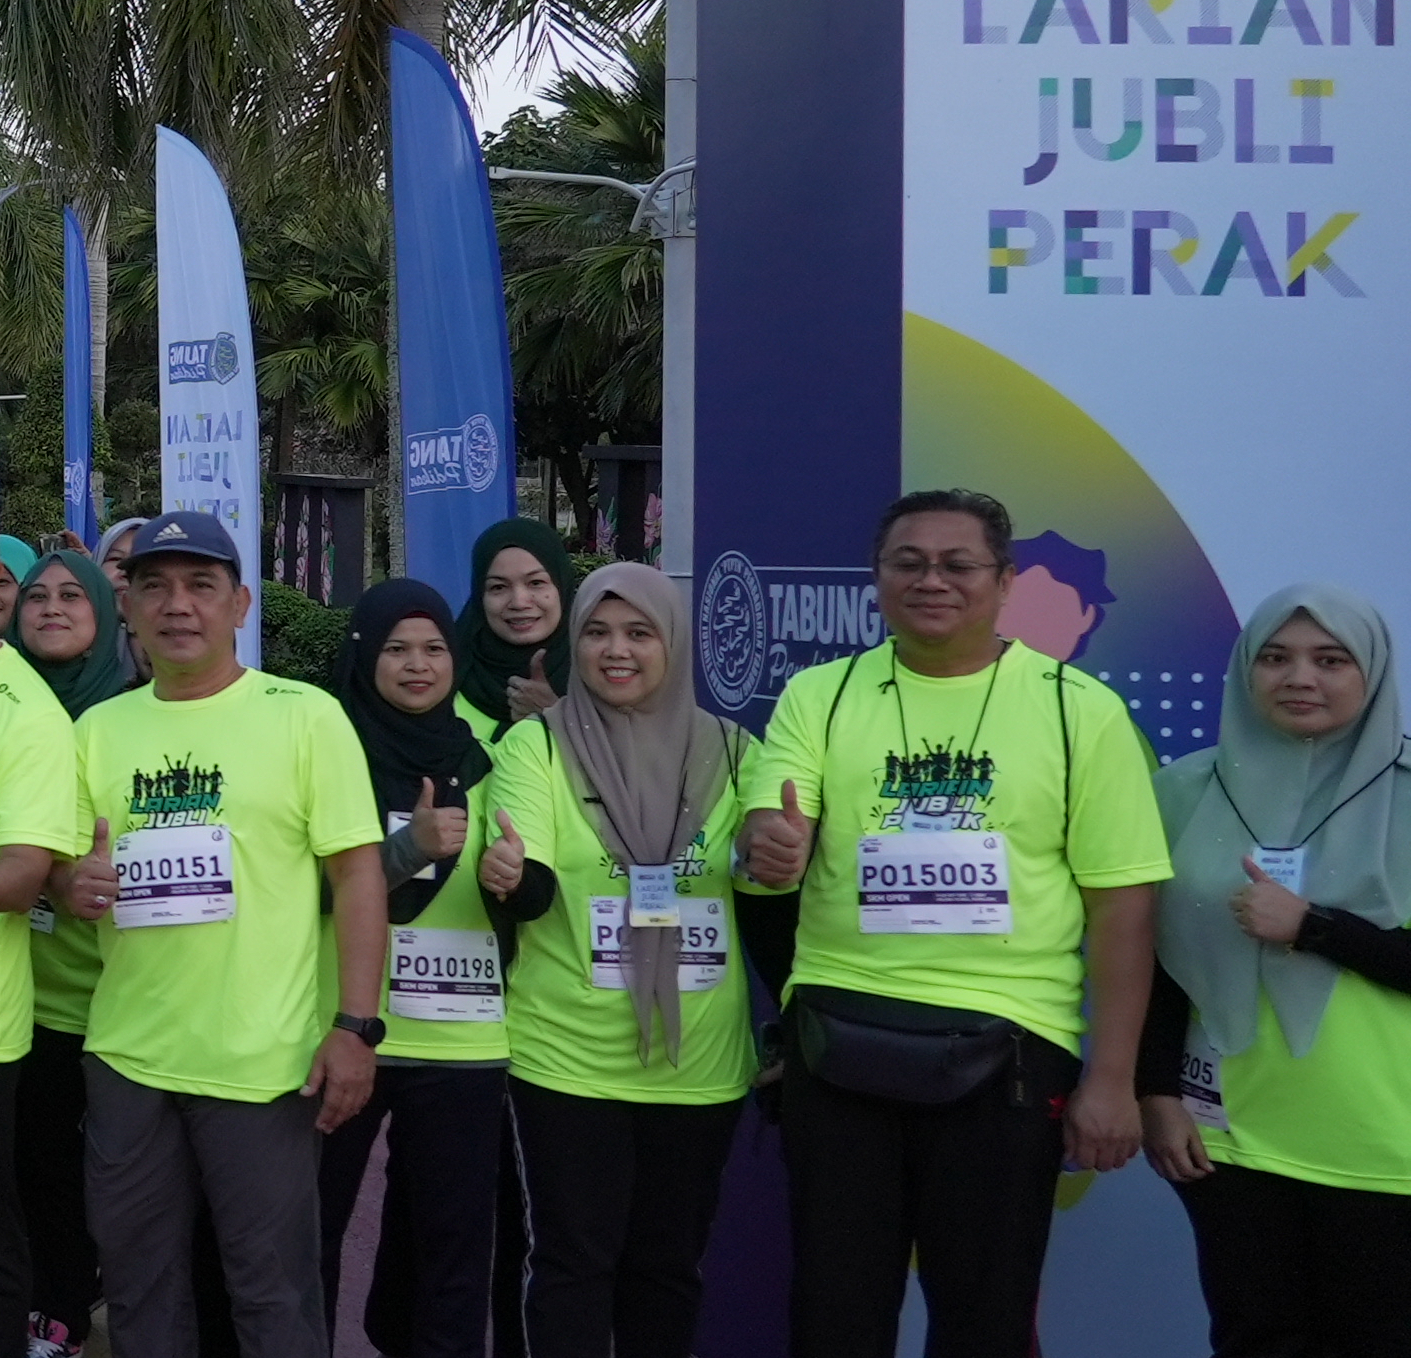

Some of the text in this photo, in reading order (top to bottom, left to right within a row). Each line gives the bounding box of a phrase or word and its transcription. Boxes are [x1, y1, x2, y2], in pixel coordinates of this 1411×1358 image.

[1023, 78, 1335, 186] JUBLI
[988, 210, 1368, 298] PERAK
[769, 583, 881, 647] TABUNG
[130, 792, 221, 814] LARIAN
[879, 779, 994, 799] LARIAN
[143, 809, 208, 828] JUBLI
